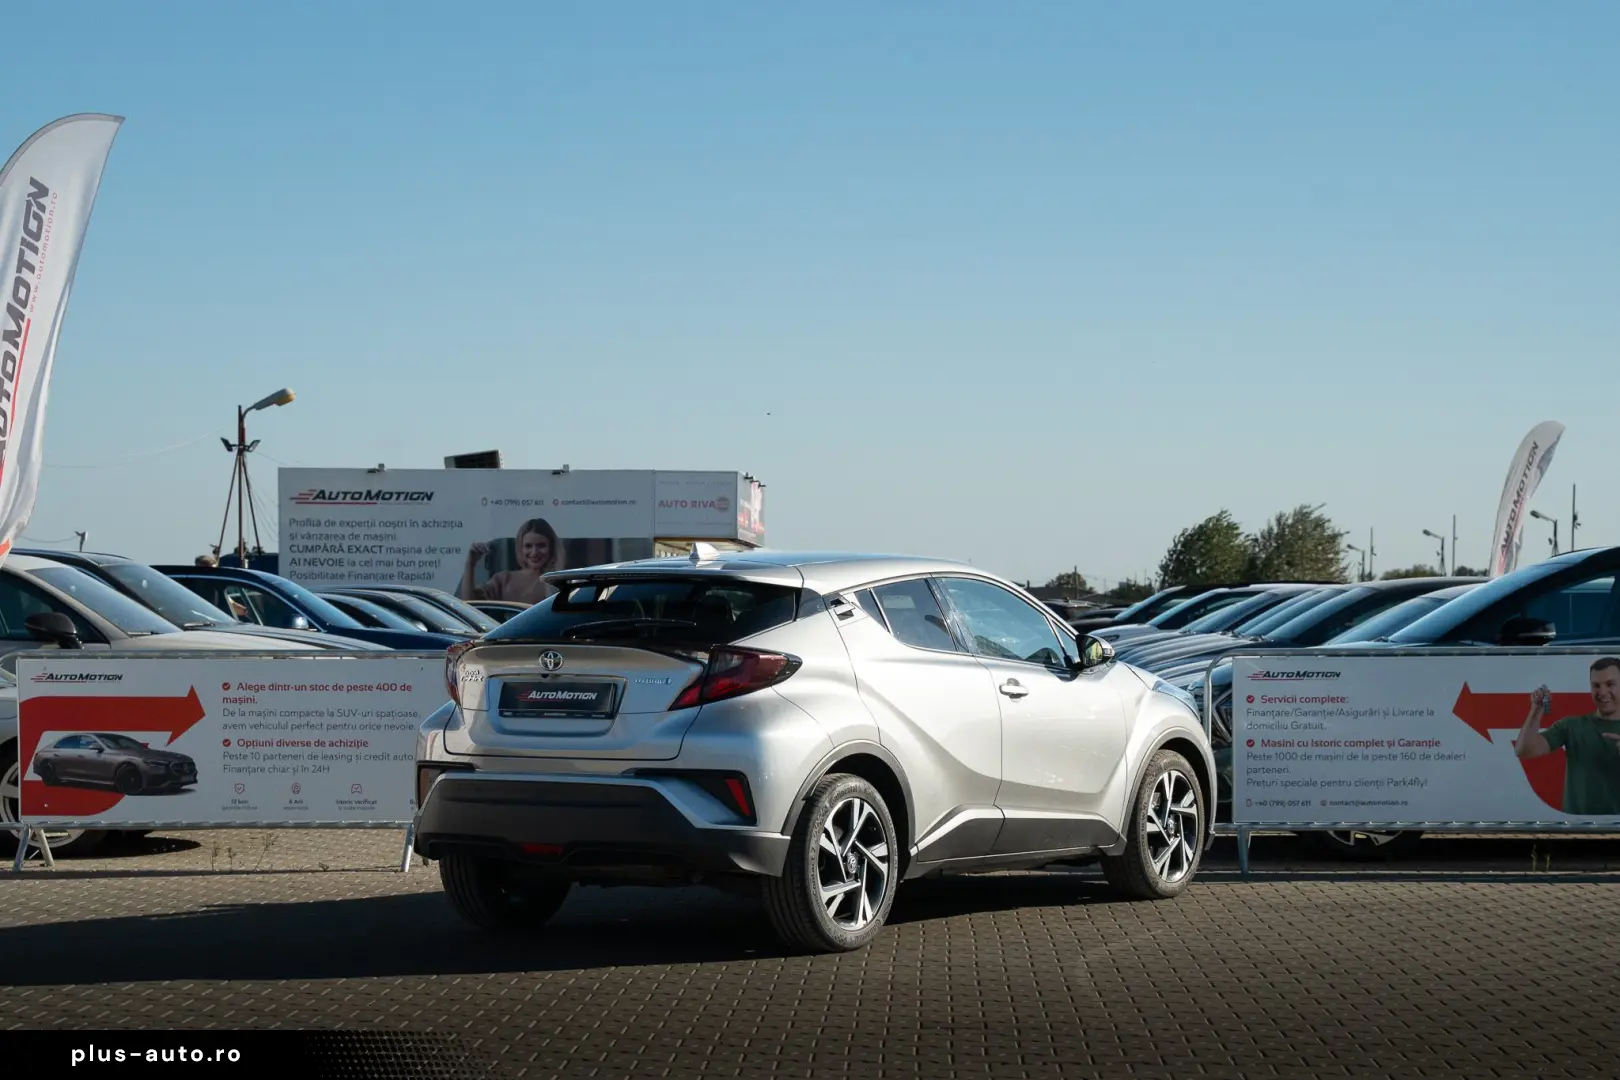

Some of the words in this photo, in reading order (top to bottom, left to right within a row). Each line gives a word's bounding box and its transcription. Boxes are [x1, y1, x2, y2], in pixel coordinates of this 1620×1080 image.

[658, 500, 688, 508] AUTO
[691, 500, 716, 508] RIVA
[324, 518, 336, 528] de
[348, 532, 360, 541] de
[348, 546, 384, 554] EXACT
[426, 545, 438, 554] de
[289, 558, 301, 567] AI
[303, 558, 345, 567] NEVOIE
[347, 558, 356, 567] la
[359, 558, 373, 567] cel
[375, 558, 394, 567] mai
[397, 558, 416, 567] bun
[290, 571, 345, 580] Posibilitate
[236, 683, 266, 693] Alege
[268, 683, 307, 691] dintr-un
[309, 683, 329, 691] stoc
[332, 683, 344, 691] de
[346, 684, 373, 693] peste
[375, 683, 397, 691] 400
[400, 683, 412, 691] de
[223, 696, 258, 705] mașini.
[1260, 695, 1297, 704] Servicii
[1299, 695, 1349, 705] complete:
[223, 708, 236, 717] De
[238, 708, 246, 717] la
[280, 710, 324, 719] compacte
[327, 708, 334, 717] la
[336, 708, 373, 717] SUV-uri
[1392, 708, 1421, 717] Livrare
[1424, 708, 1434, 717] la
[249, 721, 288, 730] vehiculul
[291, 721, 323, 732] perfect
[326, 722, 357, 732] pentru
[359, 721, 381, 730] orice
[384, 721, 416, 730] nevoie.
[1246, 721, 1288, 730] domiciliu
[237, 738, 274, 749] Opțiuni
[276, 738, 311, 748] diverse
[314, 738, 326, 748] de
[329, 738, 368, 749] achiziție
[1297, 739, 1308, 748] cu
[1311, 739, 1342, 748] Istoric
[1344, 739, 1384, 749] complet
[223, 752, 248, 760] Peste
[250, 752, 260, 760] 10
[263, 752, 305, 762] parteneri
[307, 752, 319, 760] de
[321, 752, 353, 763] leasing
[364, 751, 390, 761] credit
[1247, 752, 1272, 761] Peste
[1275, 752, 1297, 761] 1000
[1300, 752, 1312, 761] de
[1347, 752, 1359, 761] de
[1362, 752, 1369, 761] la
[1371, 753, 1397, 762] peste
[1400, 752, 1416, 761] 160
[1419, 752, 1431, 761] de
[1433, 752, 1465, 761] dealeri
[223, 765, 265, 776] Finanțare
[268, 765, 290, 774] chiar
[300, 765, 309, 774] în
[312, 765, 330, 774] 24H
[1247, 766, 1291, 775] parteneri.
[1280, 778, 1318, 788] speciale
[1320, 779, 1351, 788] pentru
